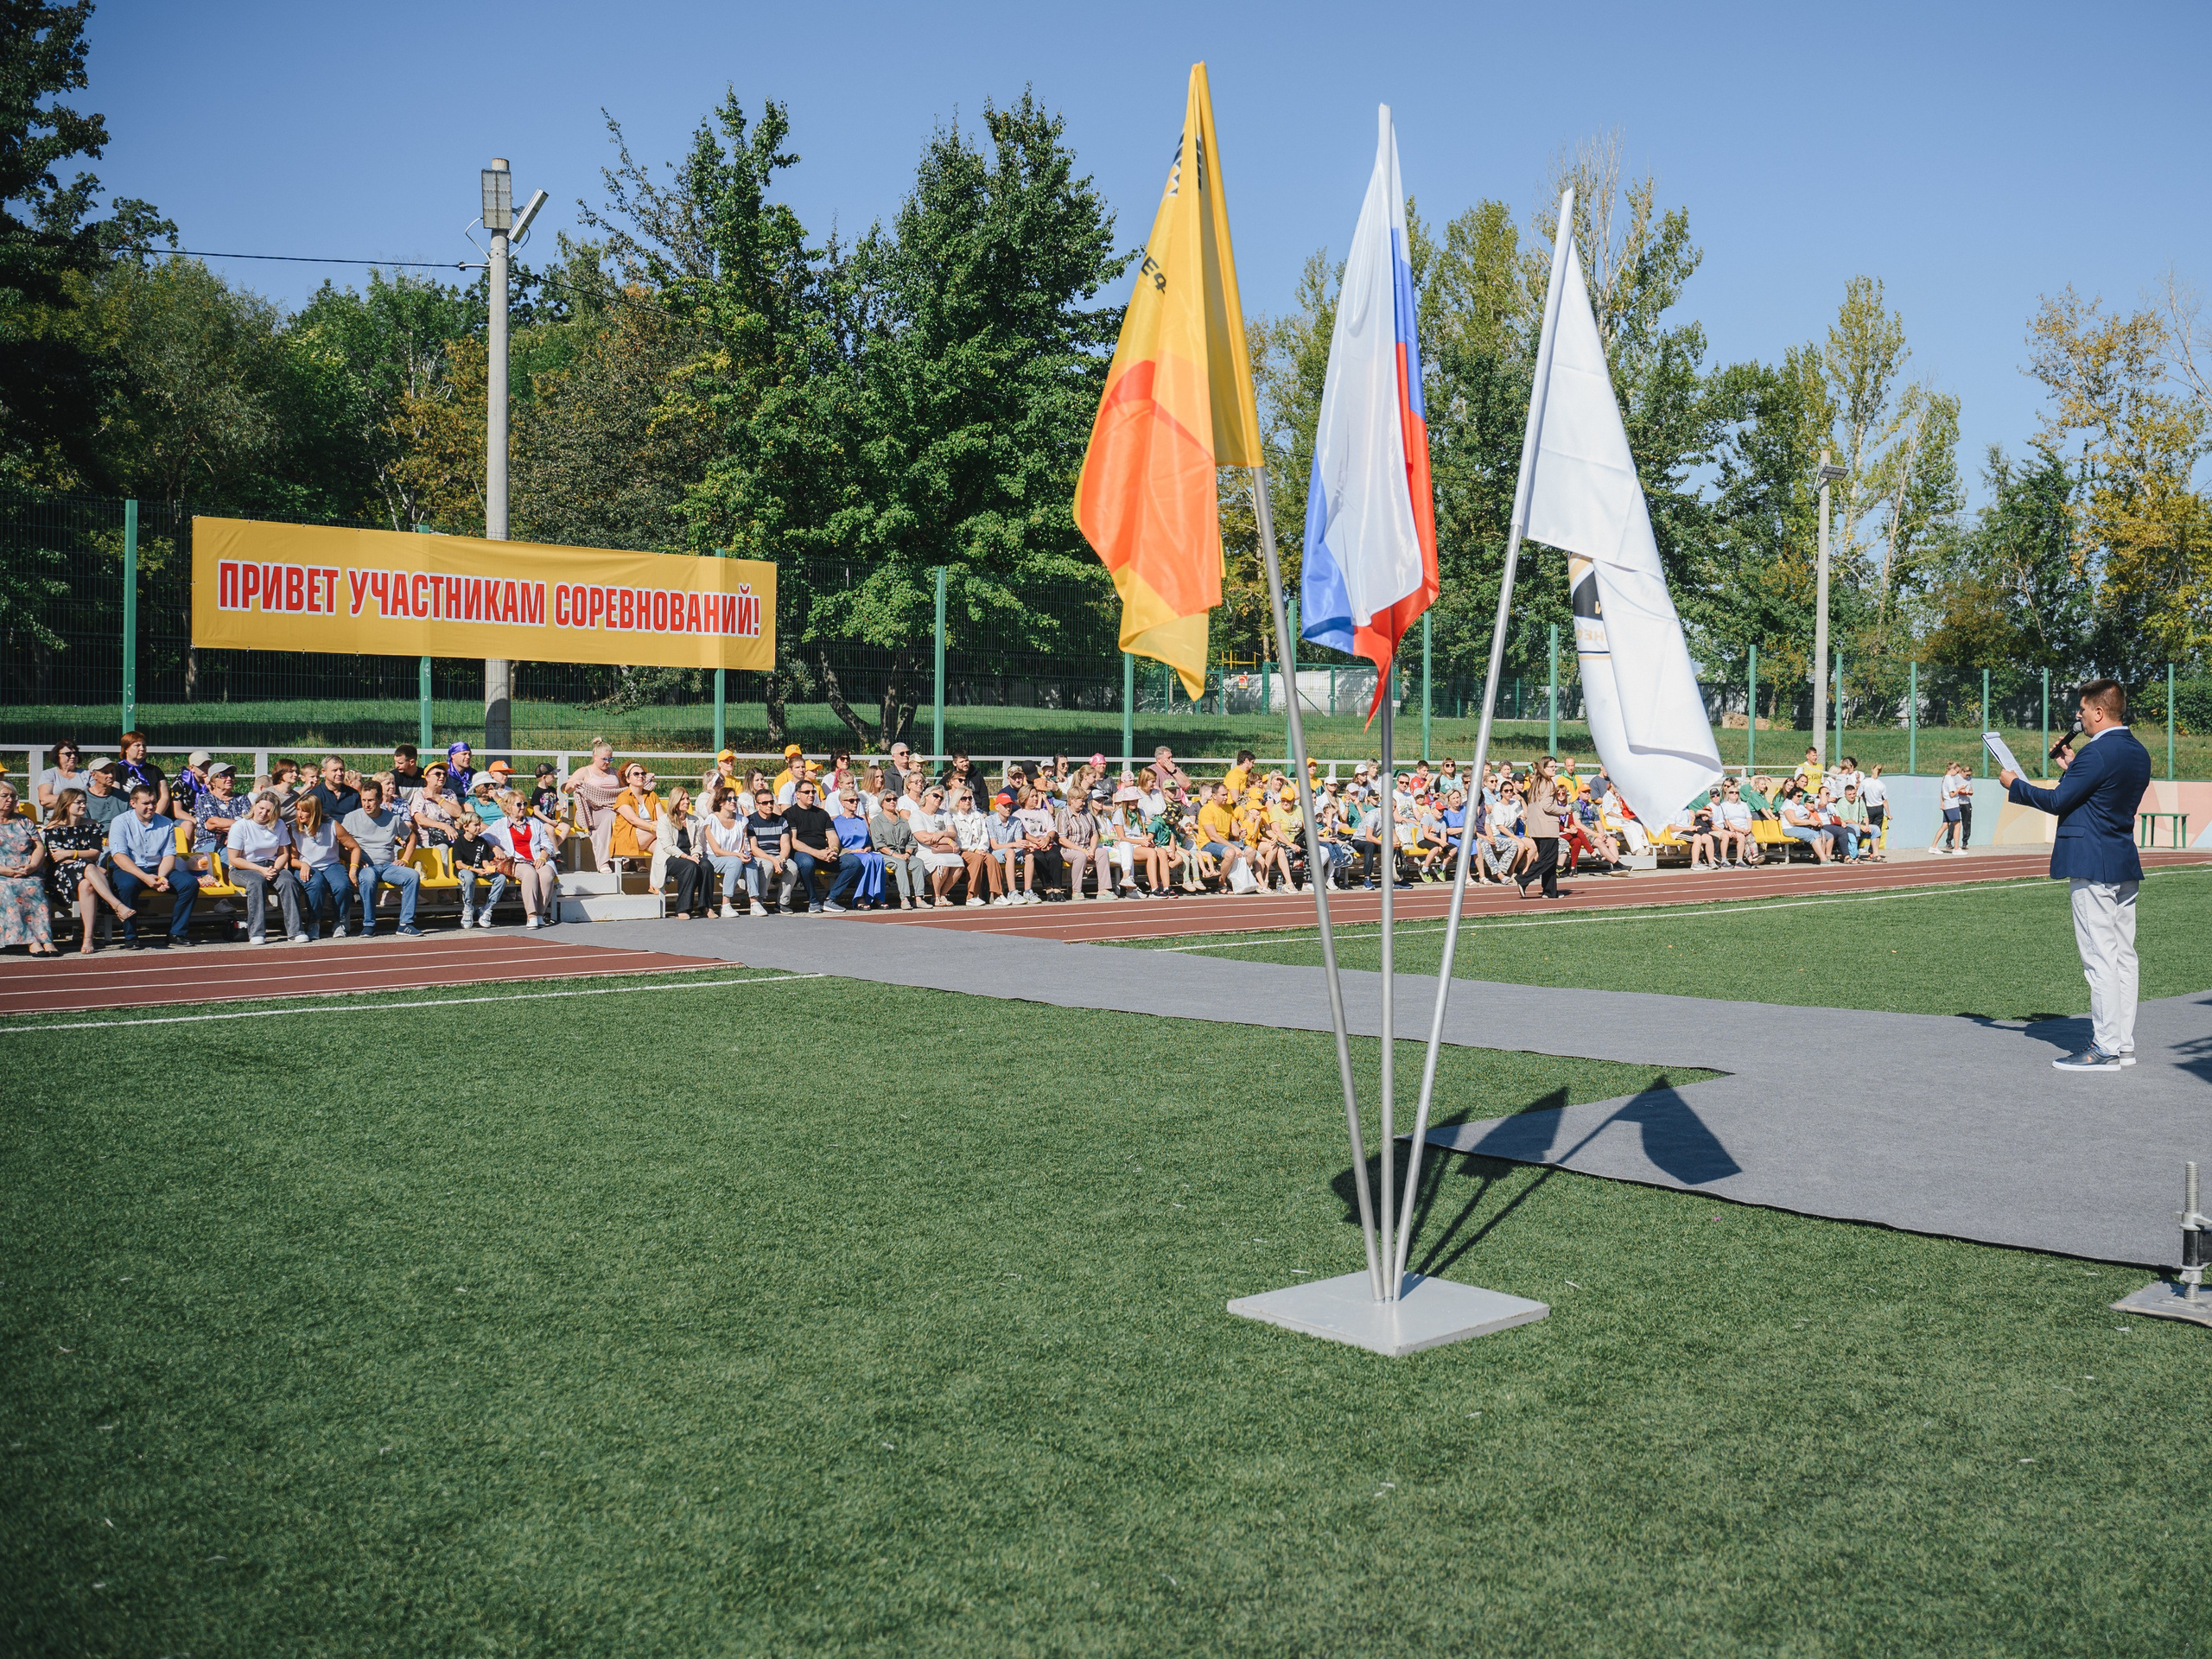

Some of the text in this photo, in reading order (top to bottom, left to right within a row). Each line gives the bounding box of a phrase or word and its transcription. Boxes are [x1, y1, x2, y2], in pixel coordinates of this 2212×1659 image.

[219, 560, 760, 638] ПРИВЕТ УЧАСТНИКАМ СОРЕВНОВАНИЙ!
